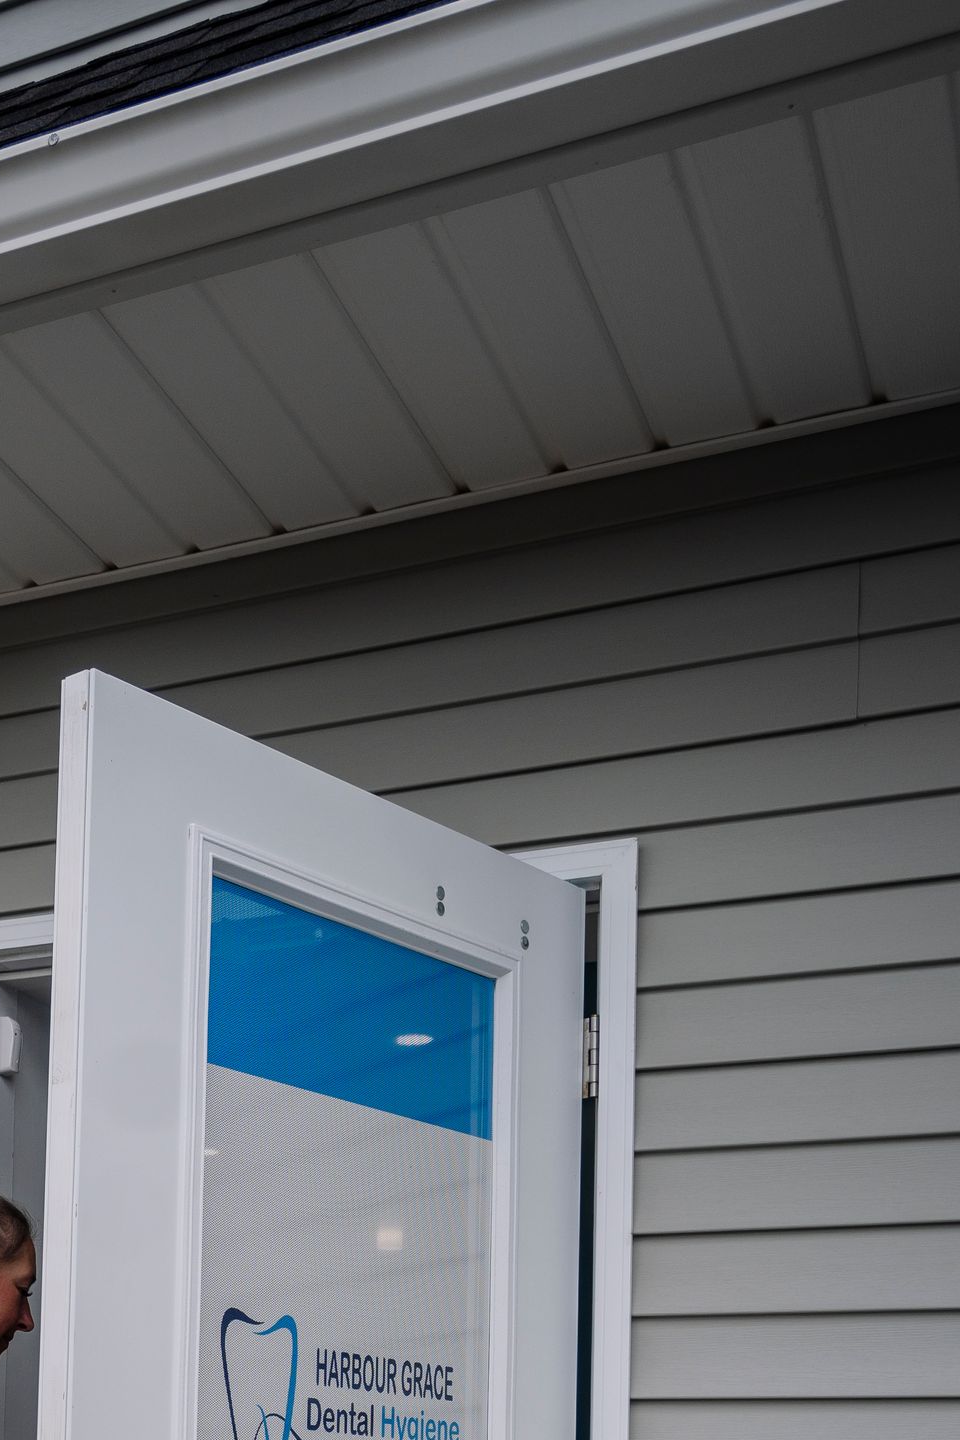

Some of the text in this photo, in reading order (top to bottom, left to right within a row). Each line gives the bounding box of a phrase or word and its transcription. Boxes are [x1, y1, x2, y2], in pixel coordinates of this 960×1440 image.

[316, 1347, 454, 1402] HARBOUR GRACE
[306, 1397, 375, 1438] Dental
